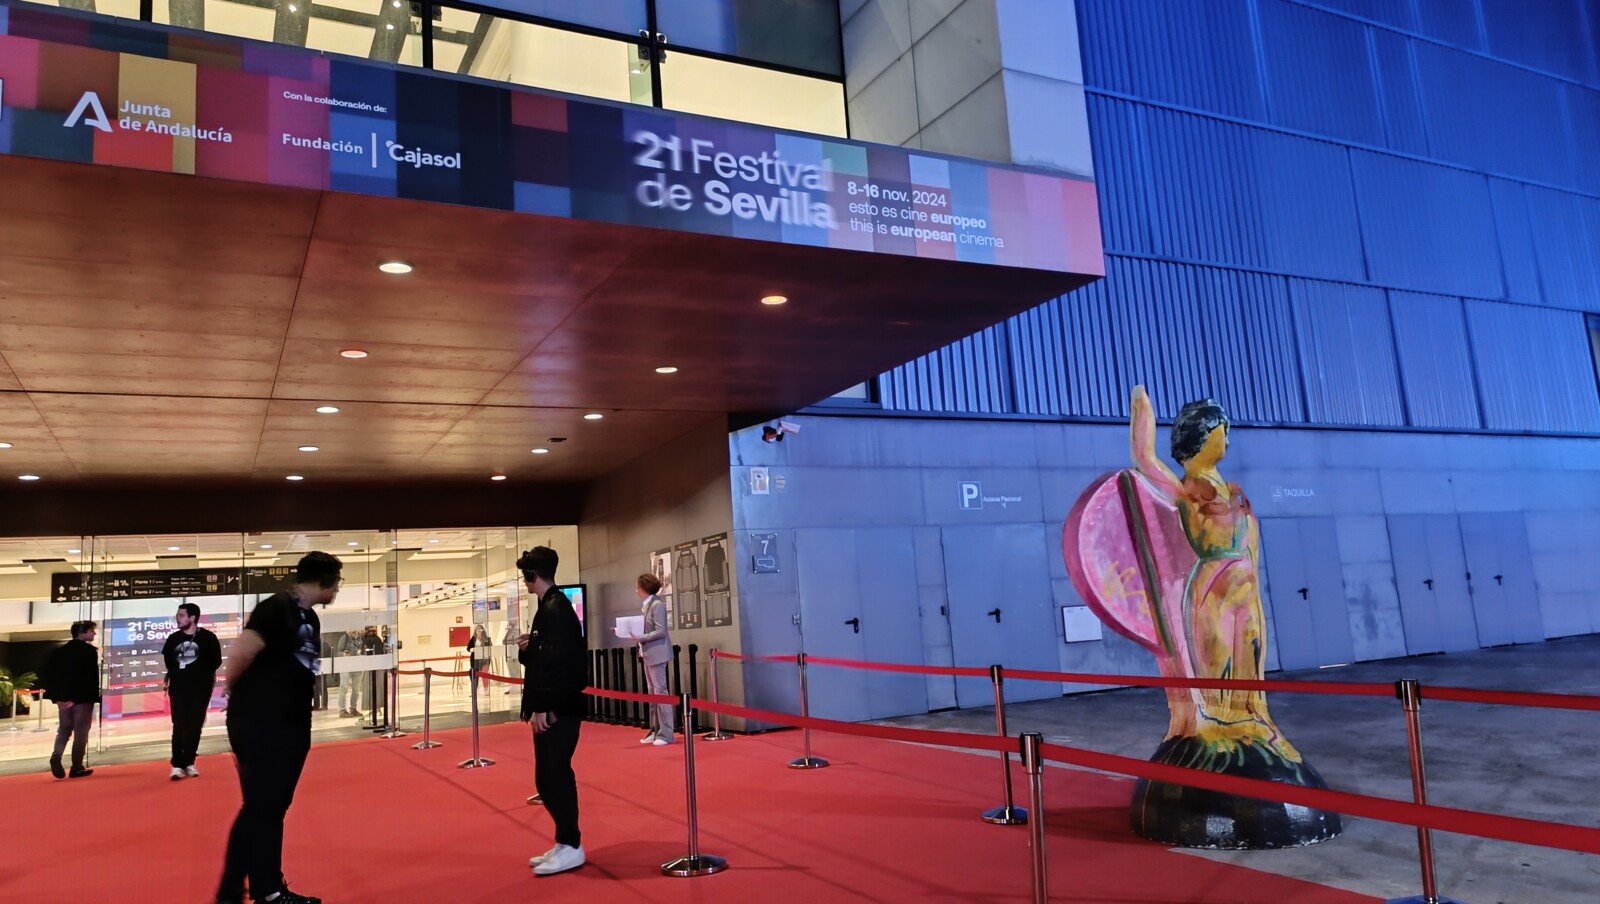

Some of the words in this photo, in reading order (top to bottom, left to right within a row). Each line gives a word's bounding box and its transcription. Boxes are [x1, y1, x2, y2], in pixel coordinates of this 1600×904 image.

[119, 100, 171, 118] Junta
[283, 90, 302, 102] Con
[304, 93, 313, 103] la
[314, 98, 372, 111] colaboración
[373, 104, 388, 114] de:
[119, 116, 142, 132] de
[145, 120, 233, 143] Andalucía
[282, 133, 364, 155] Fundación
[385, 140, 462, 169] Cajasol
[633, 130, 682, 172] 21
[690, 138, 835, 192] Festival
[635, 172, 694, 212] de
[703, 179, 839, 230] Sevilla
[847, 181, 880, 199] 8-16
[882, 189, 910, 203] nov.
[912, 190, 948, 208] 2024
[849, 201, 879, 216] esto
[881, 206, 898, 218] es
[900, 206, 928, 222] cine
[930, 212, 987, 230] europeo
[849, 217, 874, 234] this
[876, 220, 888, 235] is
[890, 224, 957, 243] european
[959, 230, 1005, 249] cinema
[962, 483, 978, 508] P
[1283, 488, 1314, 497] TAQUILLA
[761, 540, 769, 555] 7
[127, 632, 144, 642] de
[128, 621, 142, 631] 21
